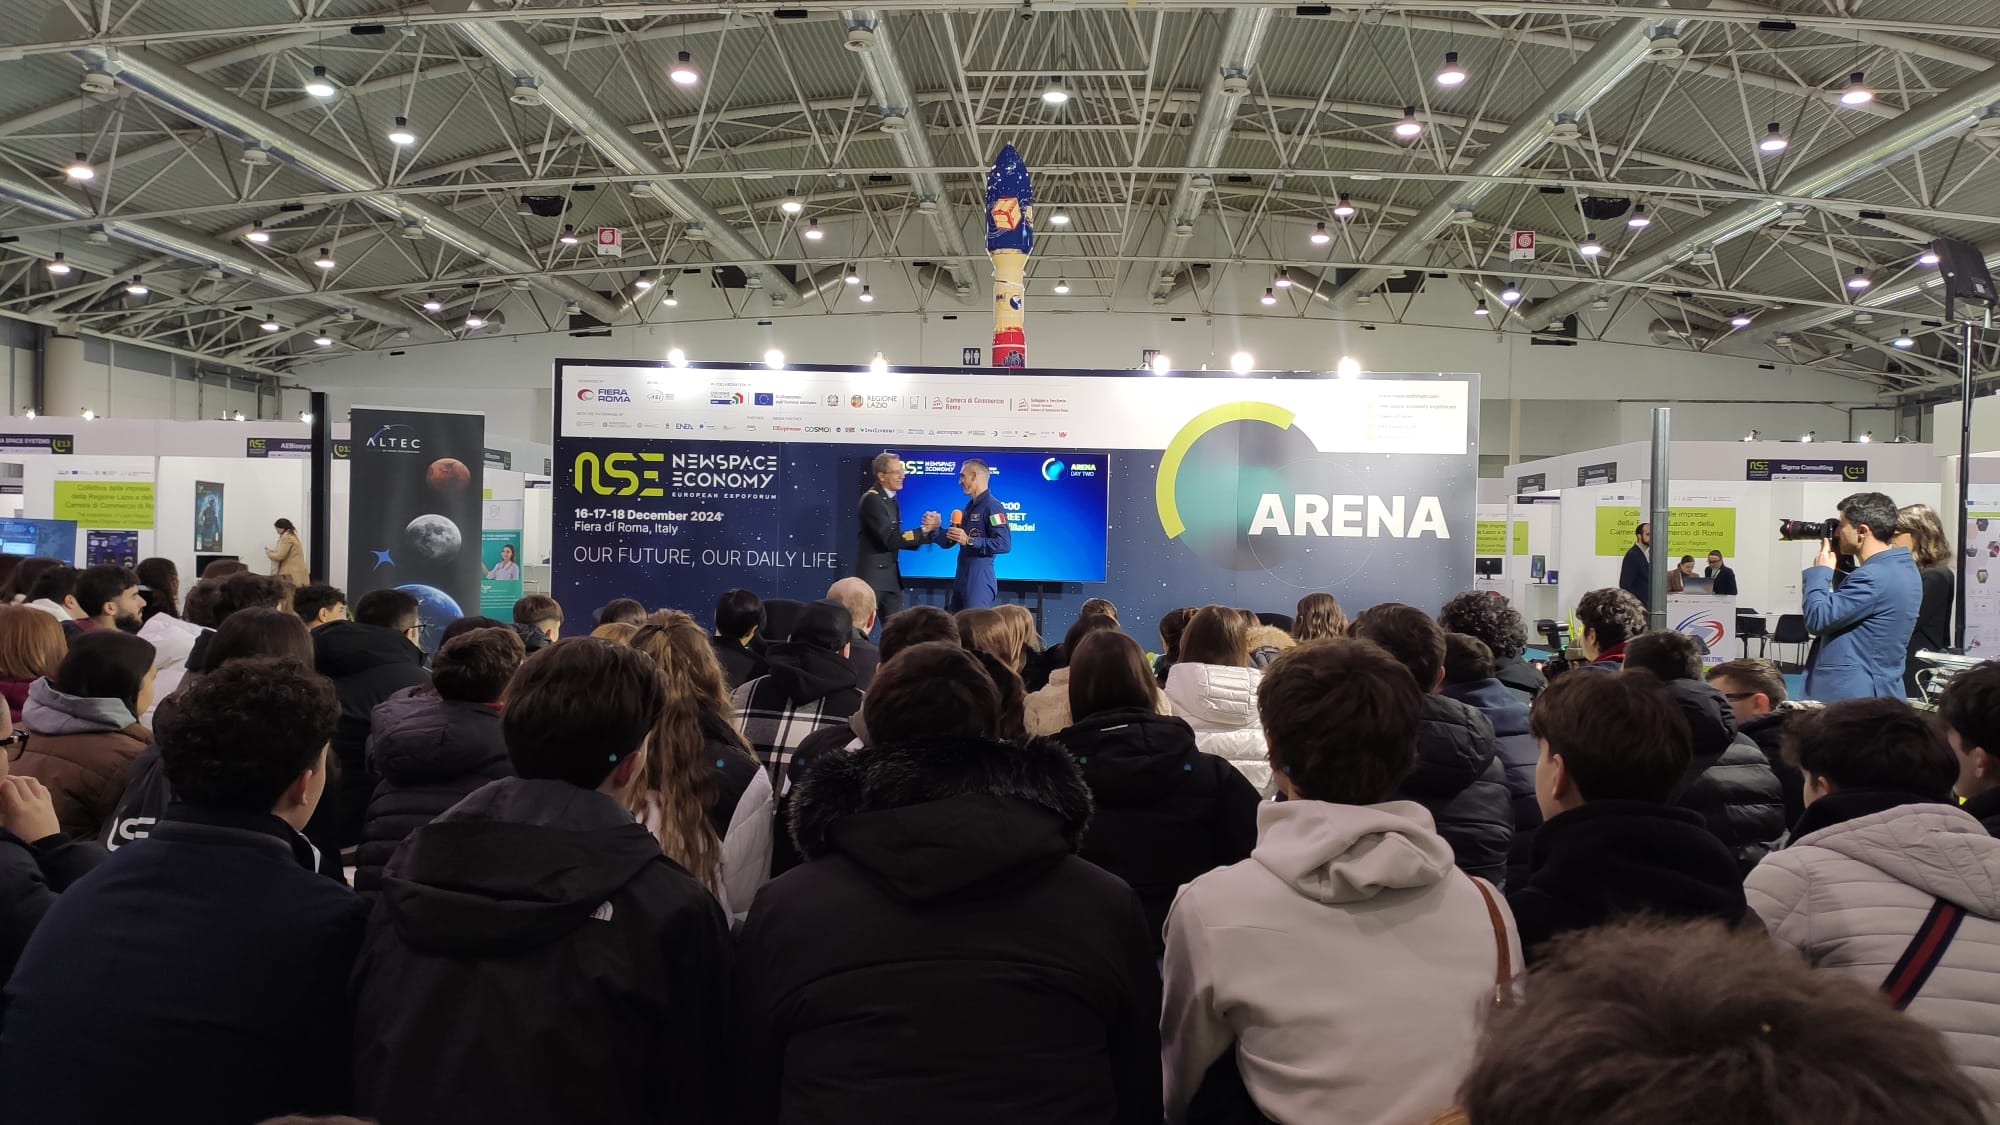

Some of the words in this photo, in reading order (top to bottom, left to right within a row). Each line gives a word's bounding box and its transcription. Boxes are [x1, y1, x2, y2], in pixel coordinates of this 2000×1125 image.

[366, 438, 420, 448] ALTEC
[672, 454, 777, 470] NEWSPACE
[1750, 462, 1768, 470] NSE
[575, 452, 664, 496] NSE
[672, 472, 774, 488] ECONOMY
[574, 508, 625, 520] 16-17-18
[627, 510, 688, 521] December
[690, 510, 721, 522] 2024
[1248, 493, 1450, 540] ARENA
[574, 521, 601, 532] Fiera
[604, 521, 616, 532] di
[618, 522, 652, 535] Roma,
[655, 522, 678, 536] Italy
[574, 546, 612, 563] OUR
[618, 547, 696, 568] FUTURE,
[702, 550, 741, 566] OUR
[747, 550, 797, 568] DAILY
[802, 552, 838, 568] LIFE
